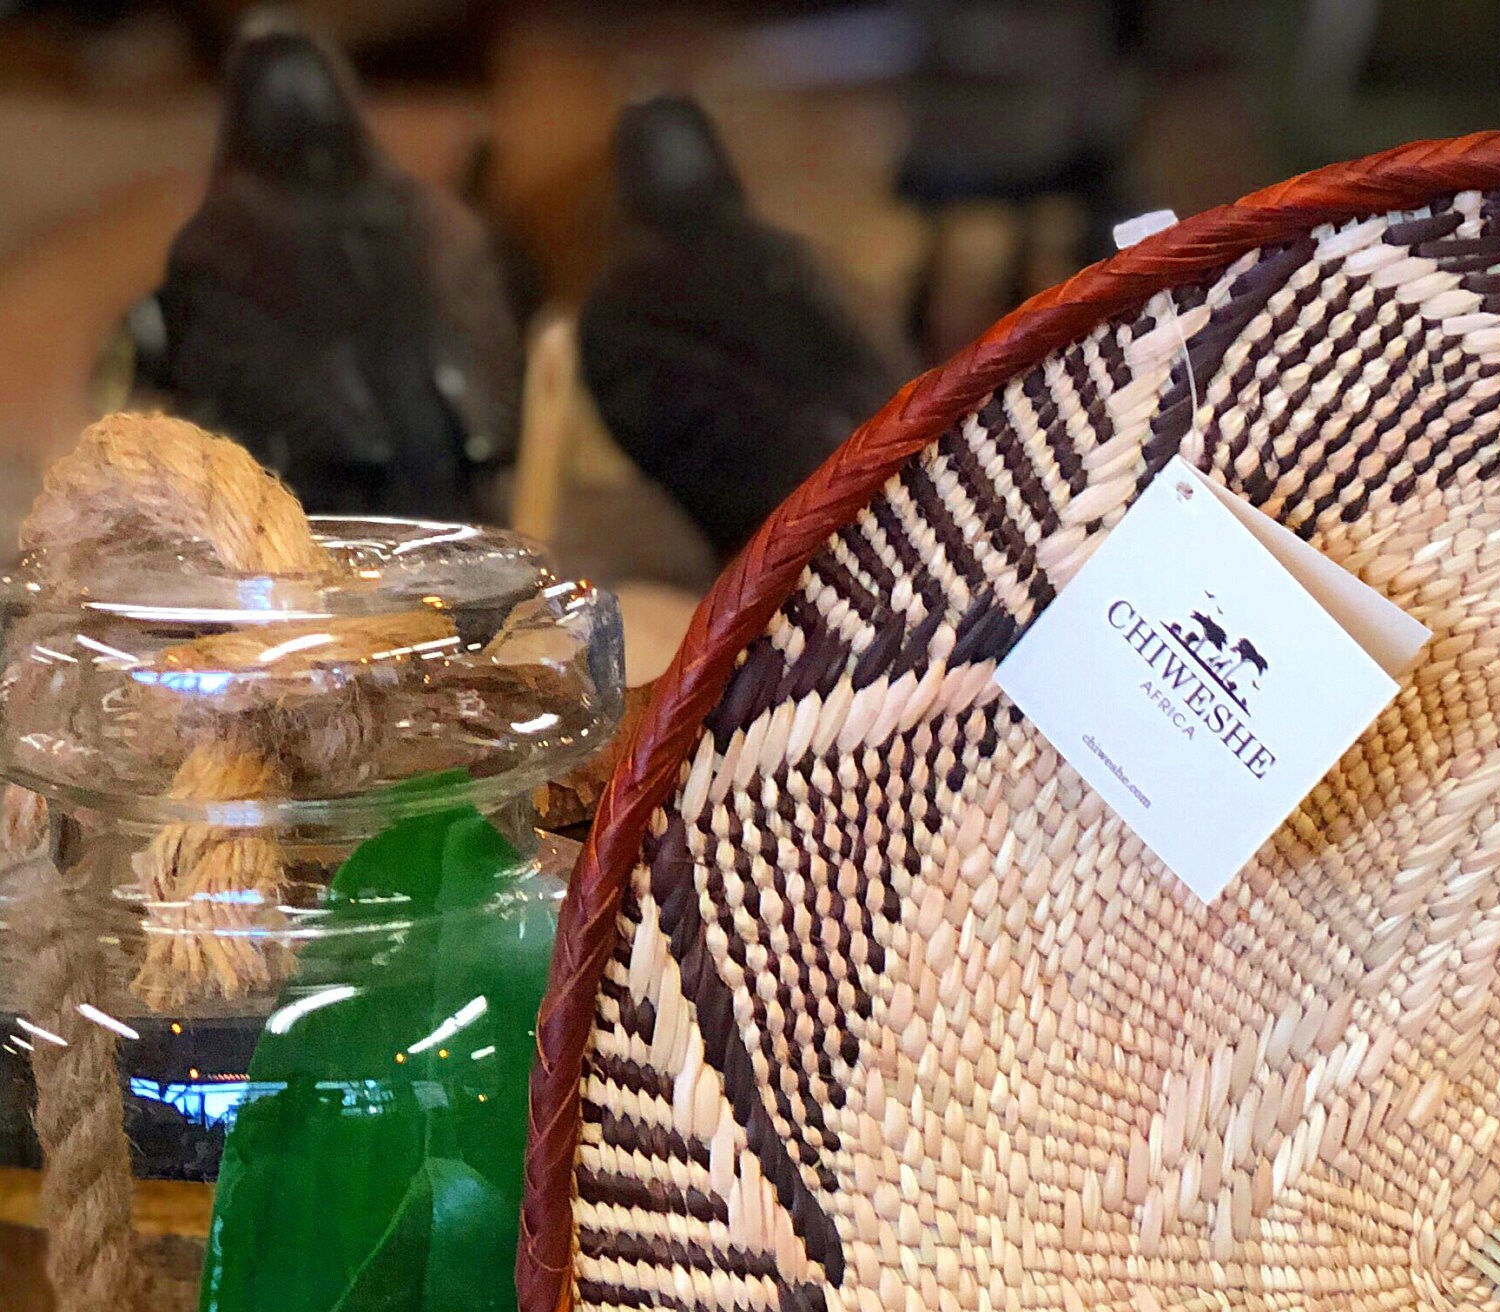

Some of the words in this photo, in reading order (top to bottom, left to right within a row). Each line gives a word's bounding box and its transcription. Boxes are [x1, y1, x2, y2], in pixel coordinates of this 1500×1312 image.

[1107, 600, 1276, 779] CHIWESHE
[1139, 680, 1196, 741] AFRICA
[1081, 733, 1152, 809] chiweshe.com
